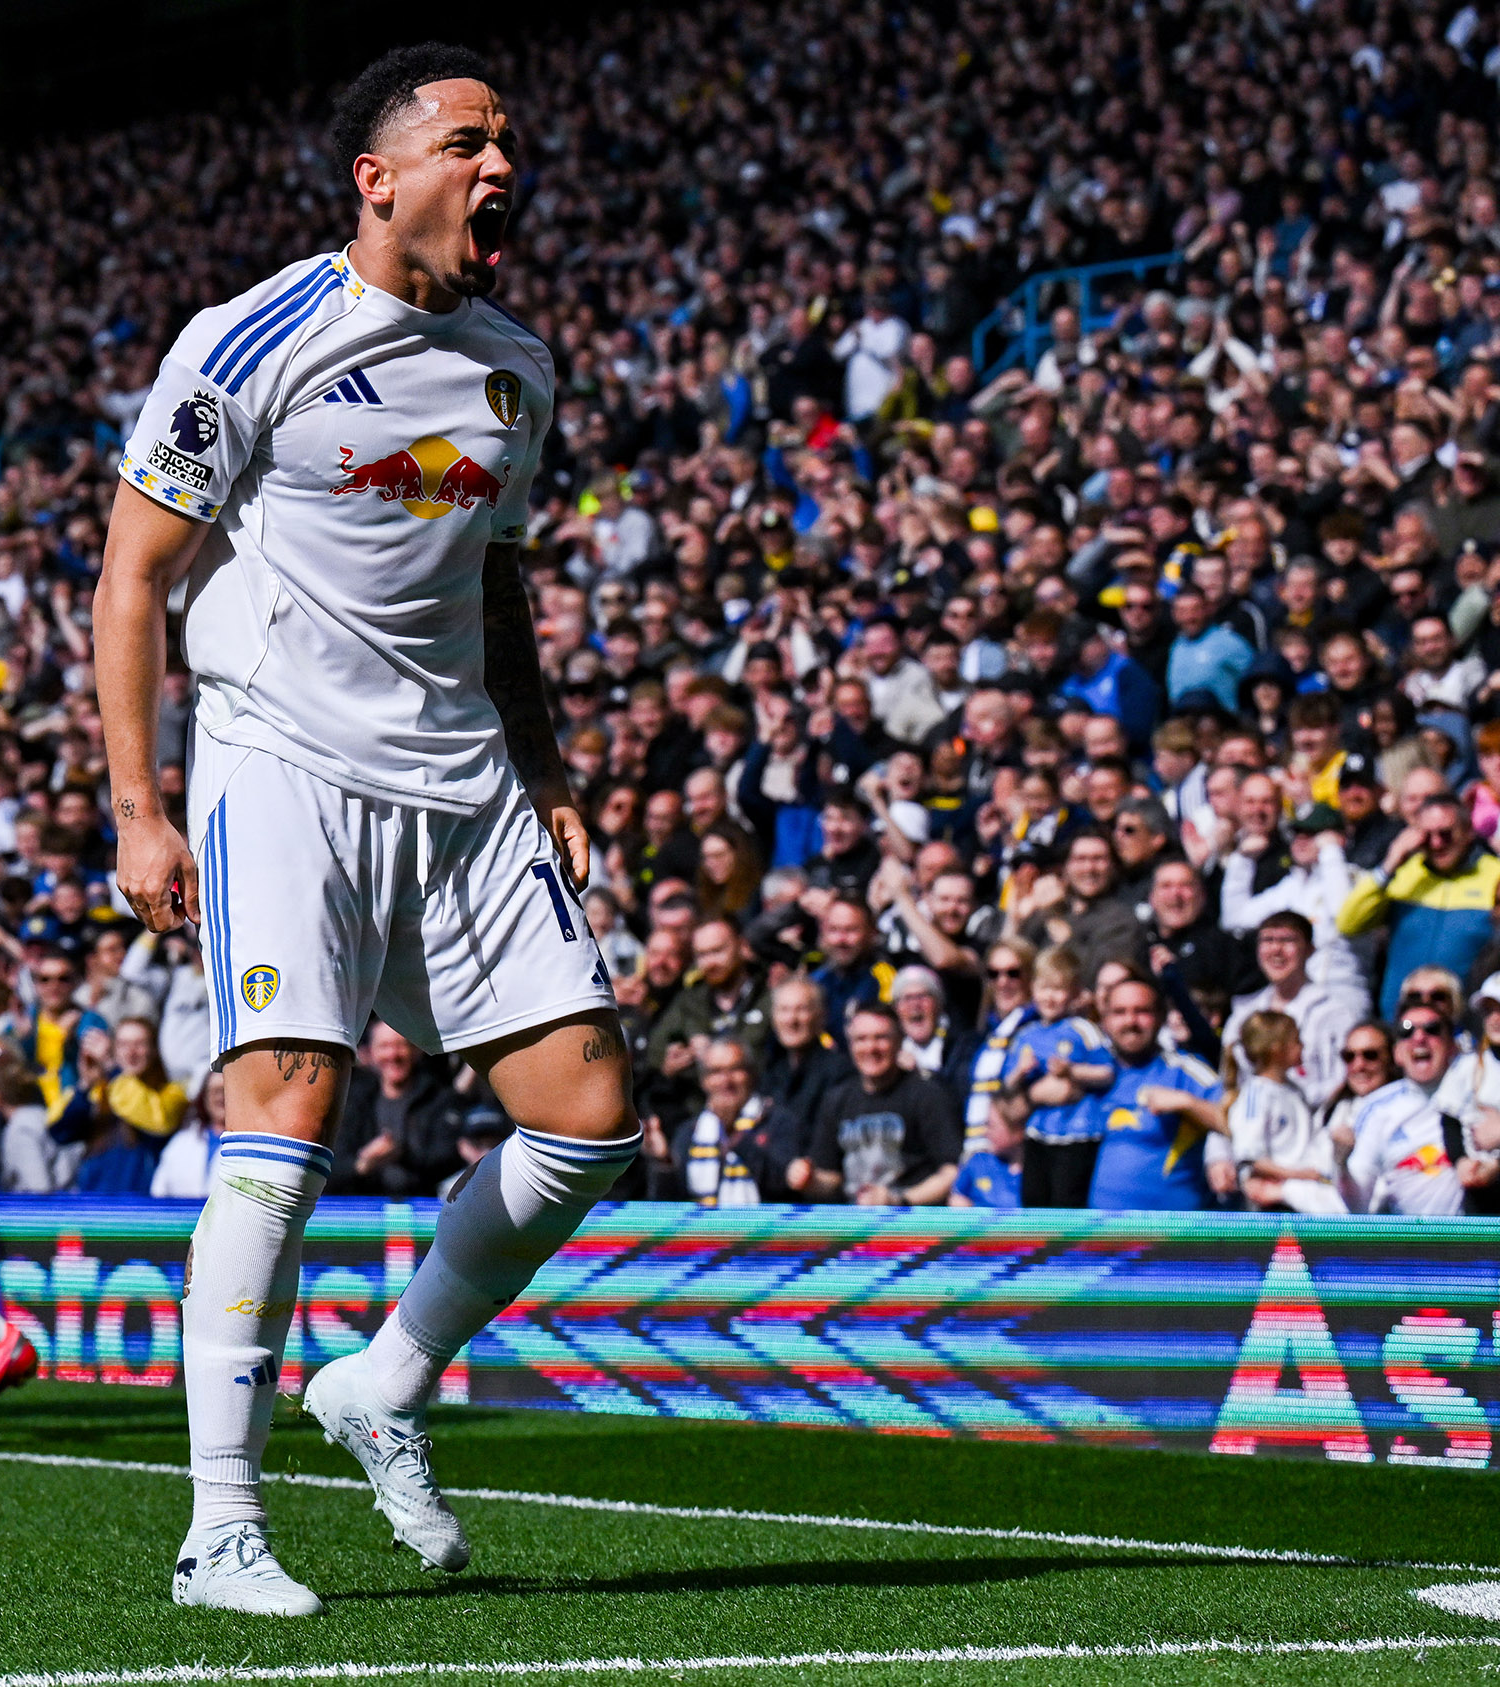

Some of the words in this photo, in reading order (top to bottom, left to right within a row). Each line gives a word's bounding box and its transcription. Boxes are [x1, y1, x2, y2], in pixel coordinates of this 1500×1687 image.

[147, 451, 166, 468] for
[164, 463, 208, 490] racism
[151, 441, 170, 459] No
[170, 453, 206, 478] room
[531, 862, 594, 942] 1
[1208, 1222, 1500, 1469] As
